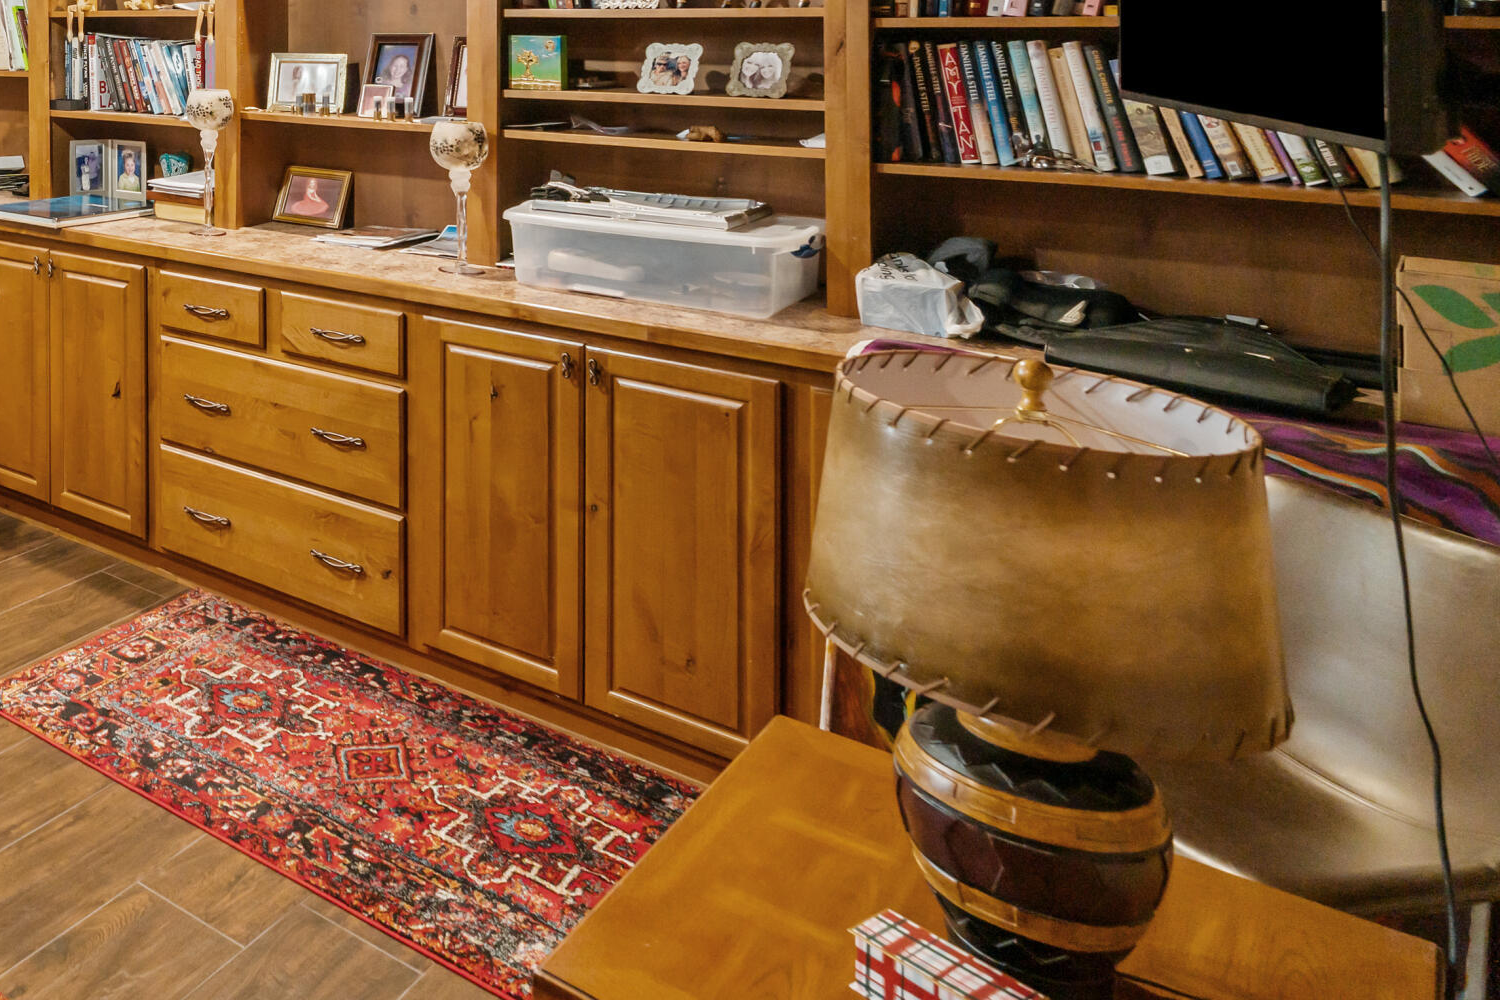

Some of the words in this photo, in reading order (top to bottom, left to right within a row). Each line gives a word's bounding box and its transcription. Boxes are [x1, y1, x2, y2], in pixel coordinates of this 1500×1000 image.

[912, 56, 926, 91] DANIELLE
[919, 90, 930, 112] STEEL
[945, 52, 961, 95] AMY
[960, 43, 974, 80] DANIELLE
[967, 79, 979, 101] STEEL
[977, 44, 992, 81] DANIELLE
[985, 80, 997, 101] STEEL
[995, 43, 1009, 79] DANIELLE
[1002, 78, 1013, 99] STEEL
[1098, 72, 1113, 104] CHRISTIE
[951, 104, 975, 153] TAN
